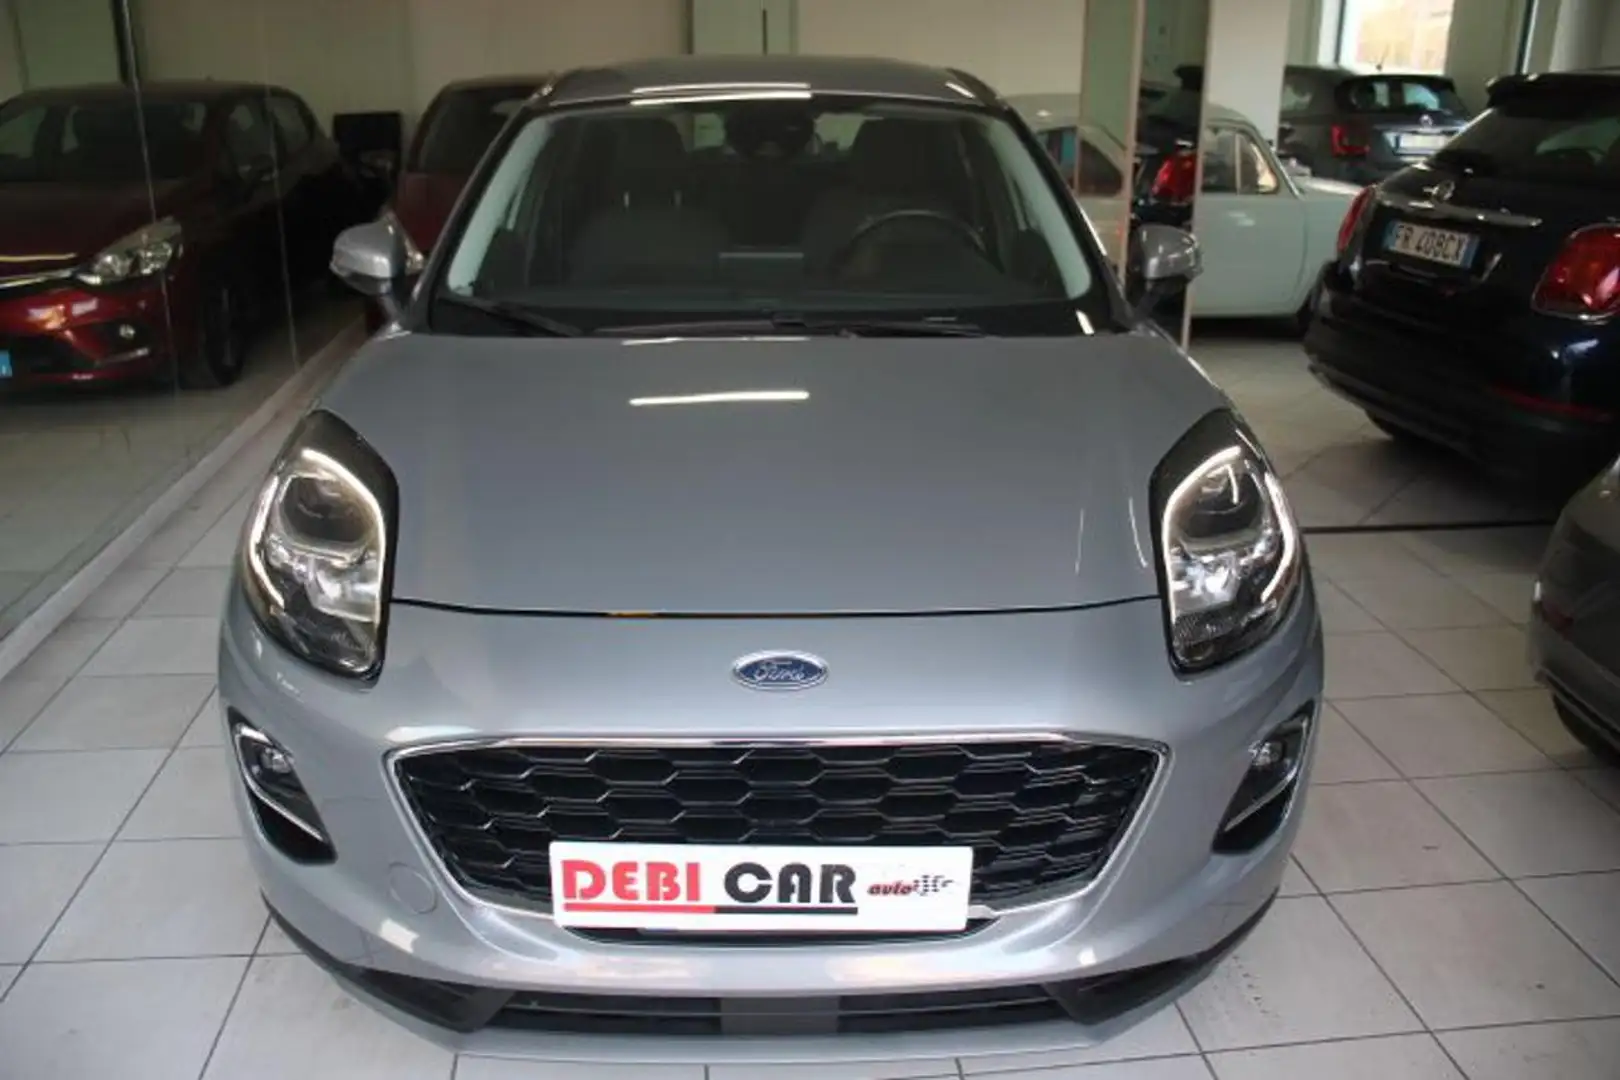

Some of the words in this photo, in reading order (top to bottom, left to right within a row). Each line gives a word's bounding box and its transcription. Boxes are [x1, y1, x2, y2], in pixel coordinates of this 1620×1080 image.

[753, 661, 806, 681] Ford
[561, 859, 701, 902] DEBI
[724, 861, 857, 904] CAR
